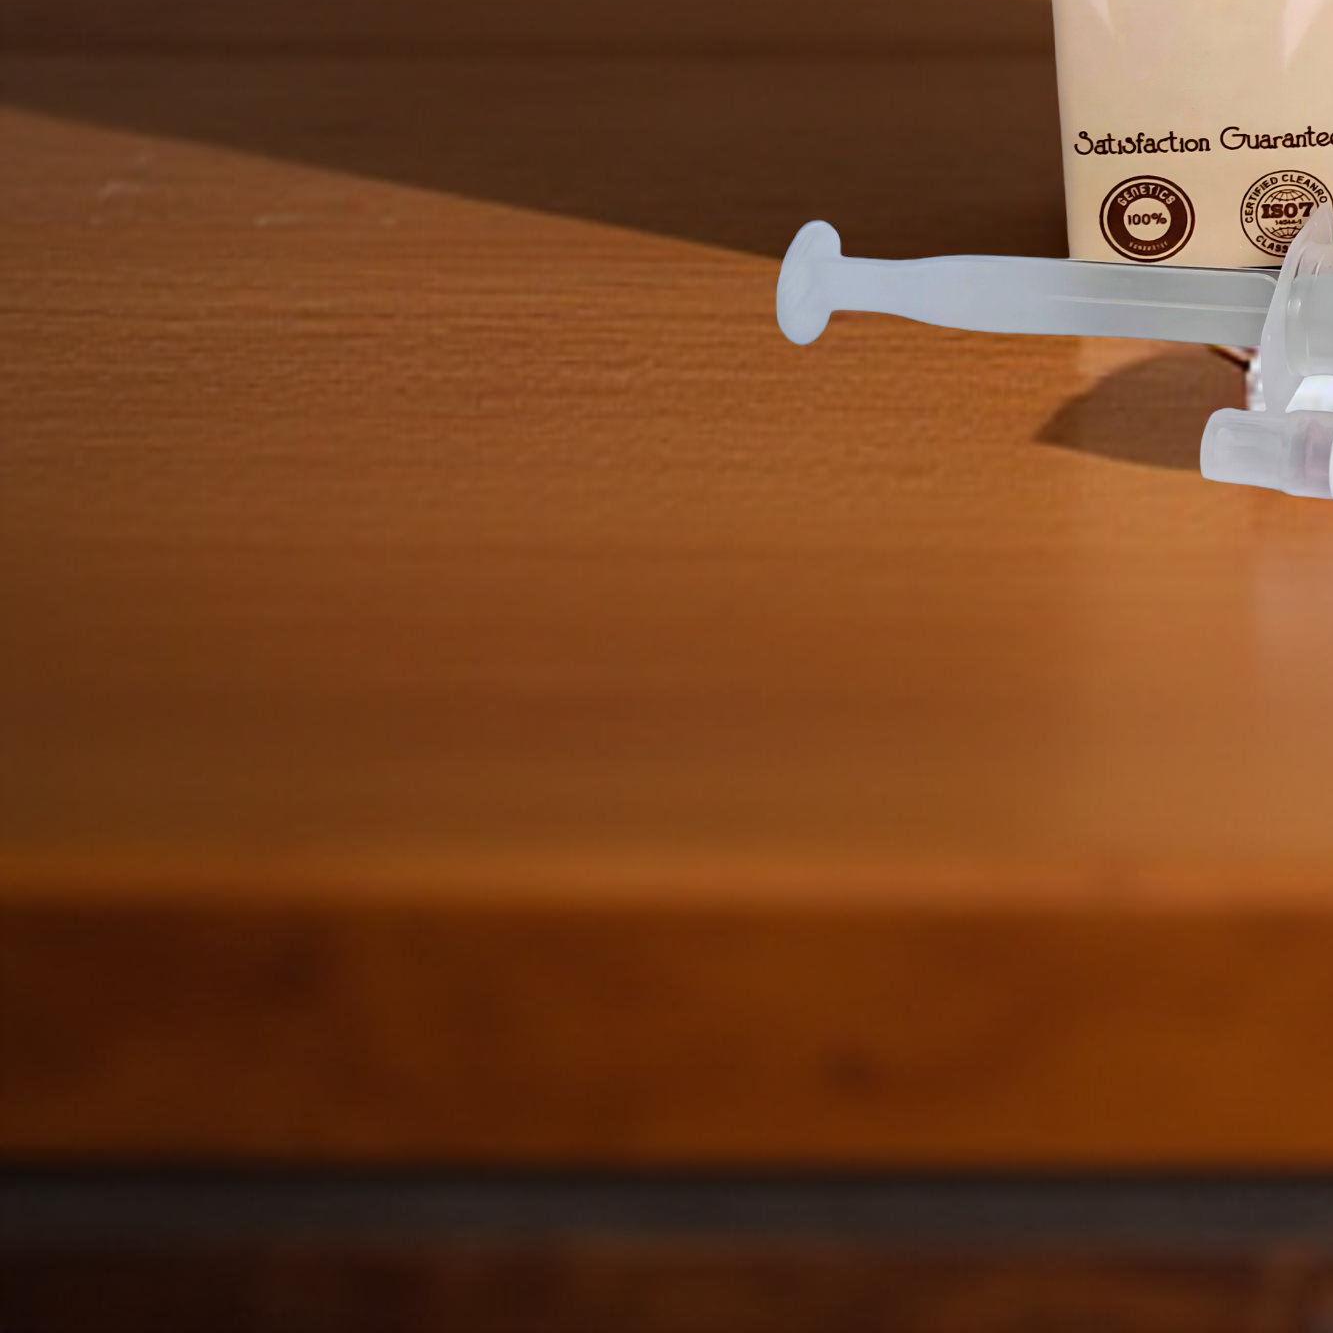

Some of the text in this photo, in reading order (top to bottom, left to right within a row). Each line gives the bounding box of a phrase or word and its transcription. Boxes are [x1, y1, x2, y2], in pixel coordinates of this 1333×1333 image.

[1073, 130, 1212, 156] Satisfaction
[1117, 184, 1176, 207] GENETICS
[1244, 174, 1328, 224] CERTIFIED CLEANRO
[1127, 213, 1167, 225] 100%
